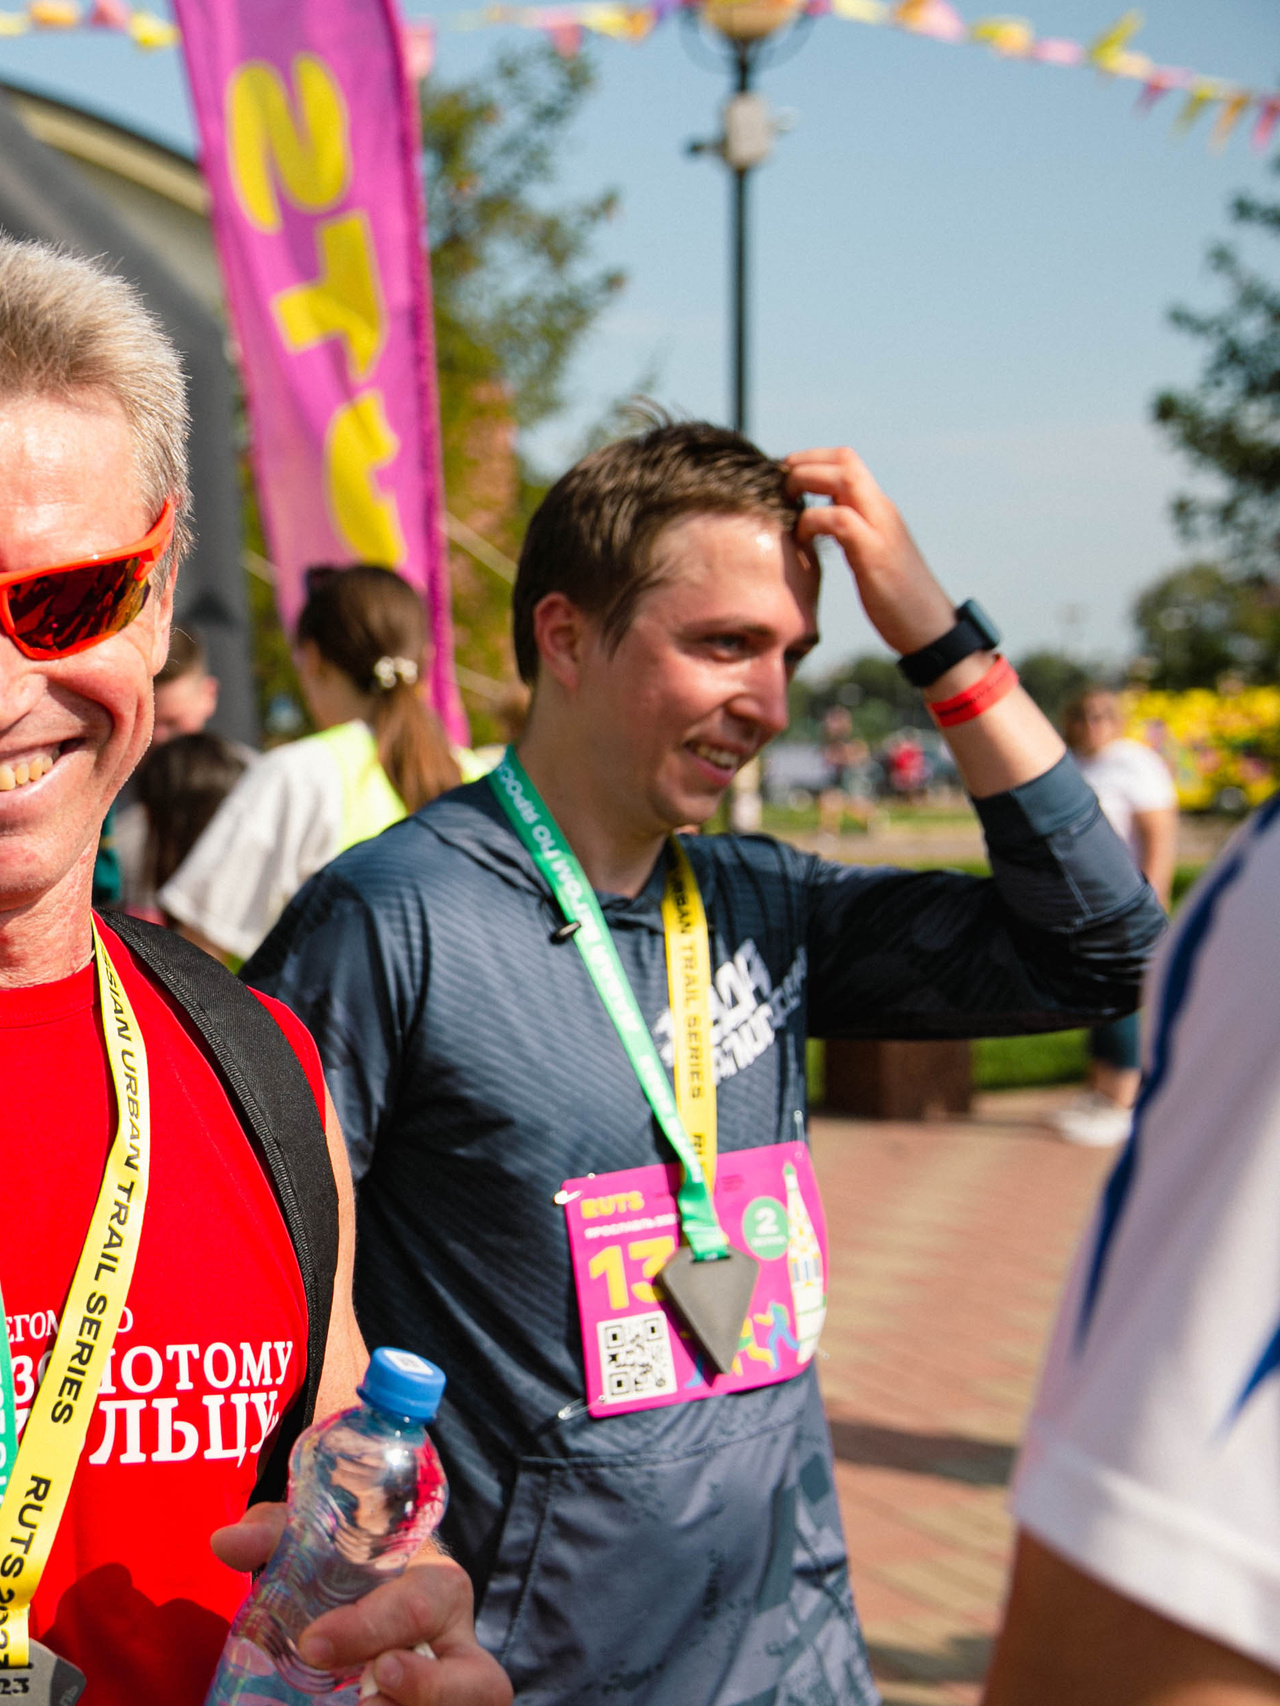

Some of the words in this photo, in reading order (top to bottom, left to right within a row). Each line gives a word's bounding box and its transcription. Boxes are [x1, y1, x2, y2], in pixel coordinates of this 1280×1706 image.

[121, 1049, 140, 1171] URBAN
[93, 1181, 136, 1282] TRAIL
[581, 1191, 645, 1219] RUTS
[754, 1206, 780, 1236] 2
[51, 1291, 108, 1425] SERIES
[0, 1475, 52, 1579] RUTS
